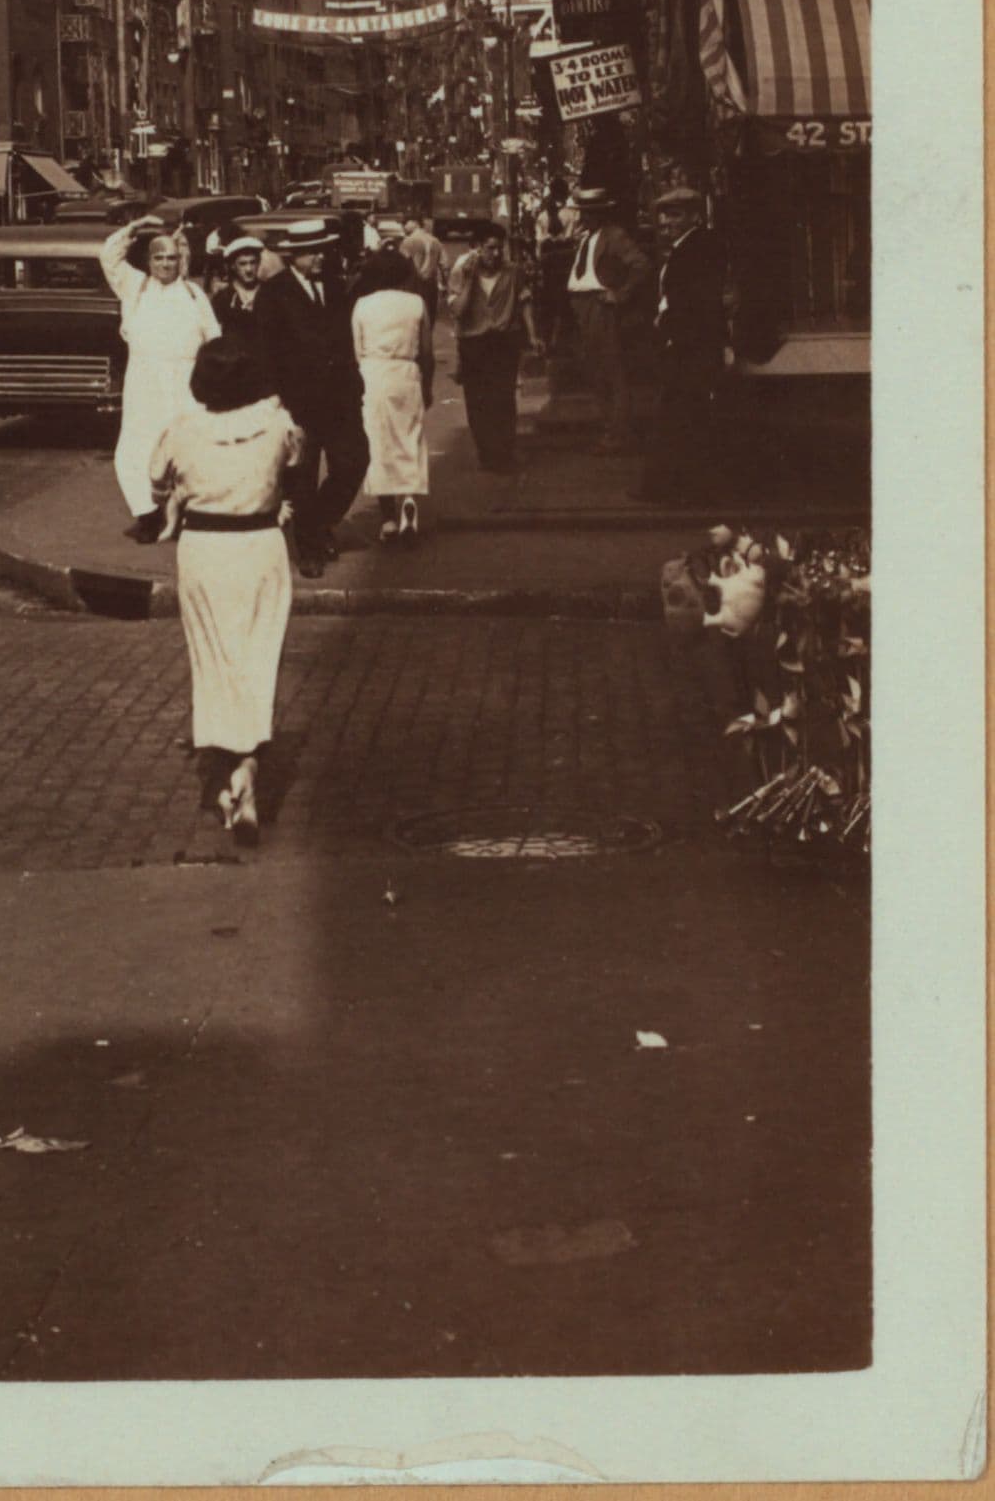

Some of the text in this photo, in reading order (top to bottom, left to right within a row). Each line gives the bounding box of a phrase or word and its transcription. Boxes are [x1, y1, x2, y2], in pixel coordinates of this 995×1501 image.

[566, 63, 625, 85] TO LET
[558, 85, 587, 106] HOT
[786, 120, 872, 147] 42 ST
